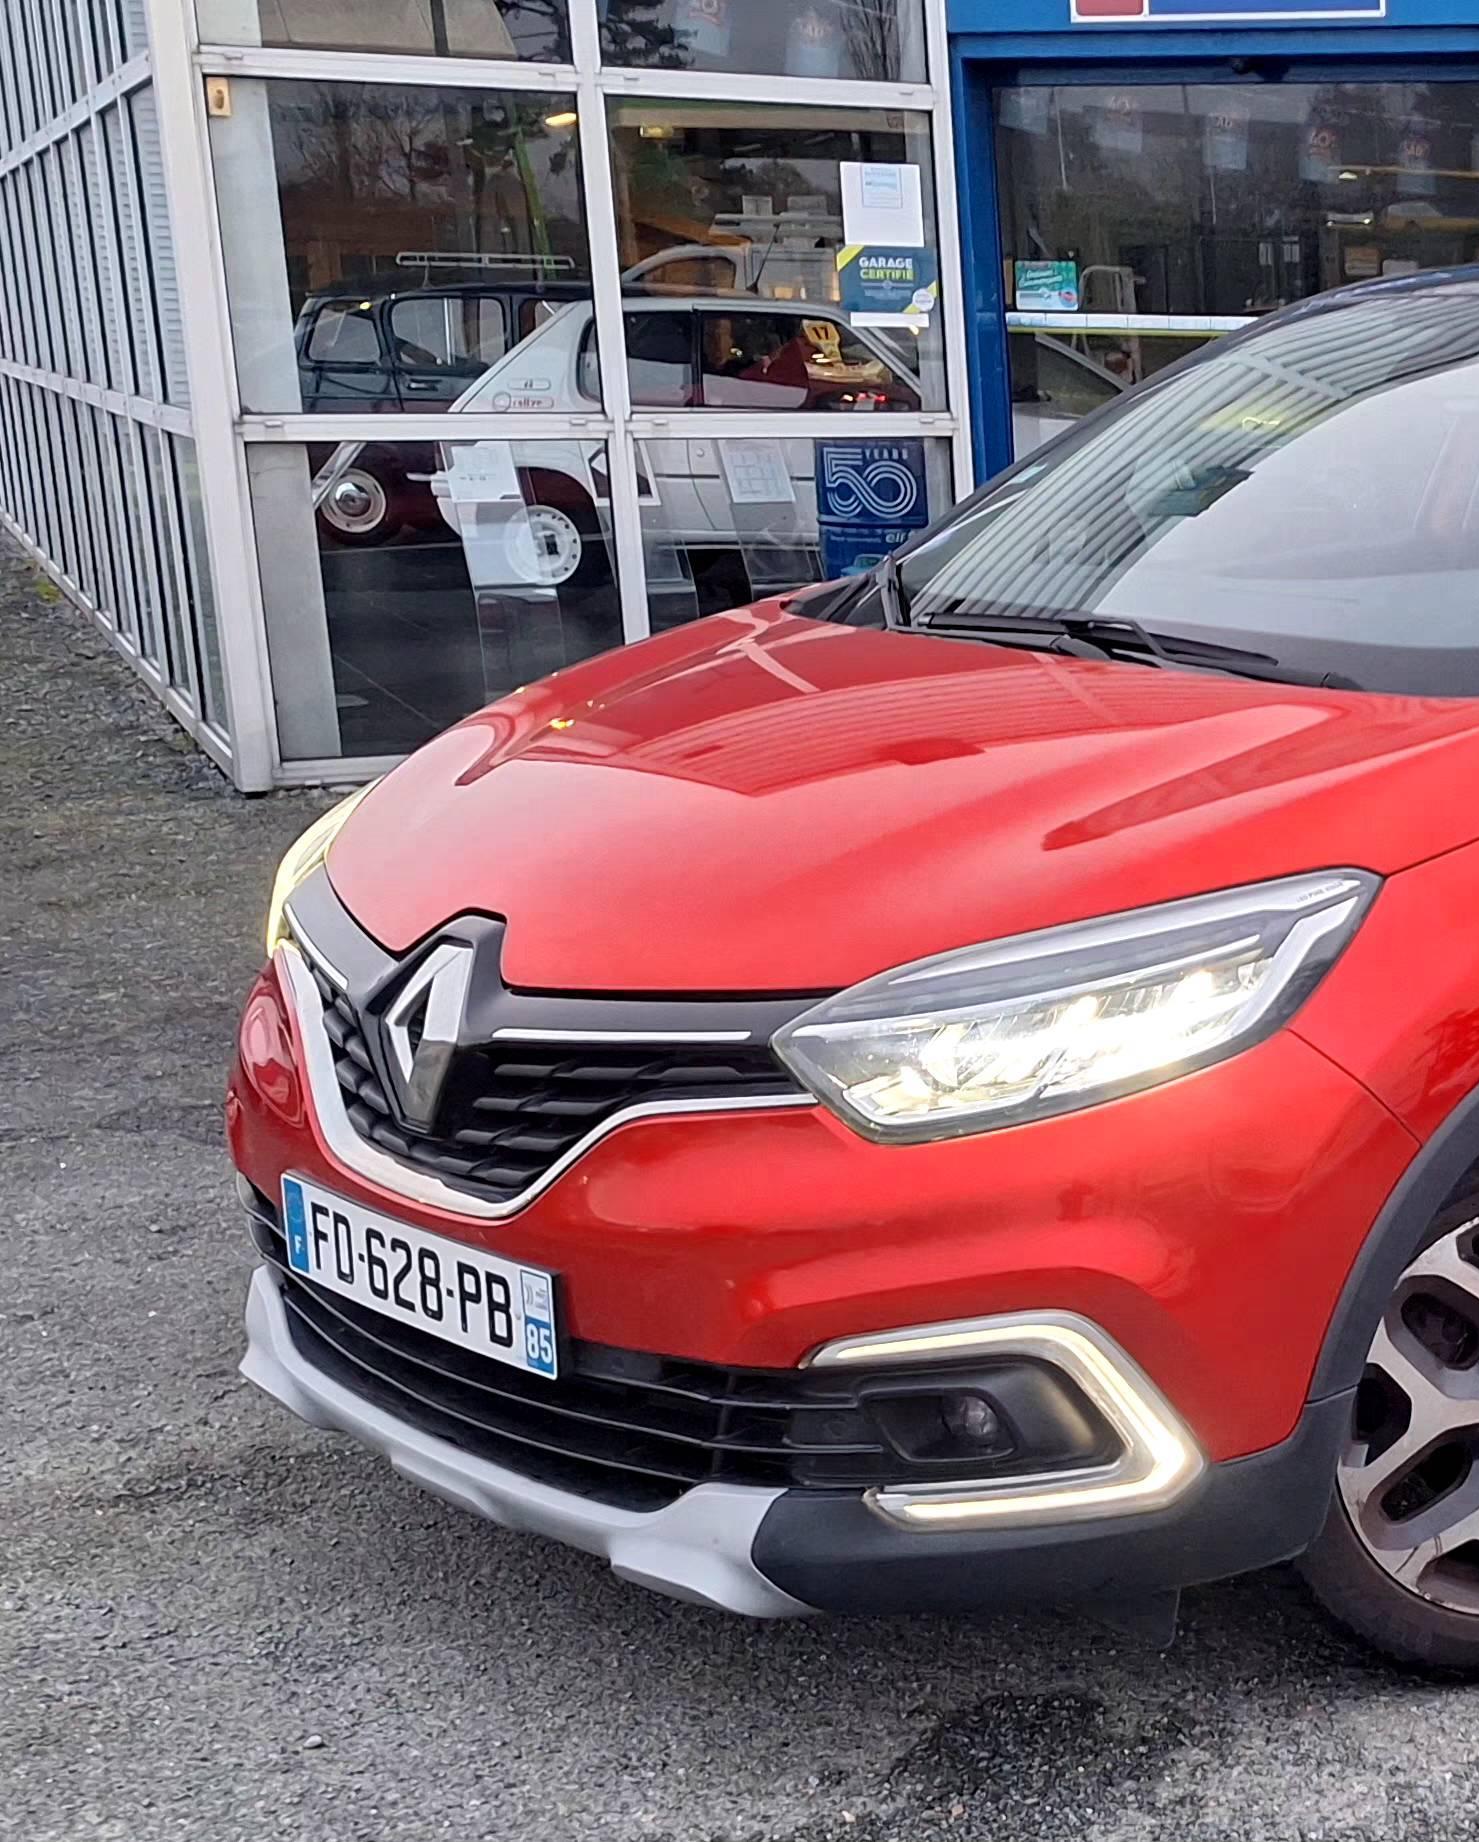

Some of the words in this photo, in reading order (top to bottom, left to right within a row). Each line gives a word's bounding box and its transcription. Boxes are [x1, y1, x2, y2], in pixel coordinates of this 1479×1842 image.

[859, 257, 913, 269] GARAGE
[294, 1235, 302, 1255] F
[310, 1201, 513, 1349] FD-628-PB
[526, 1323, 551, 1363] 85
